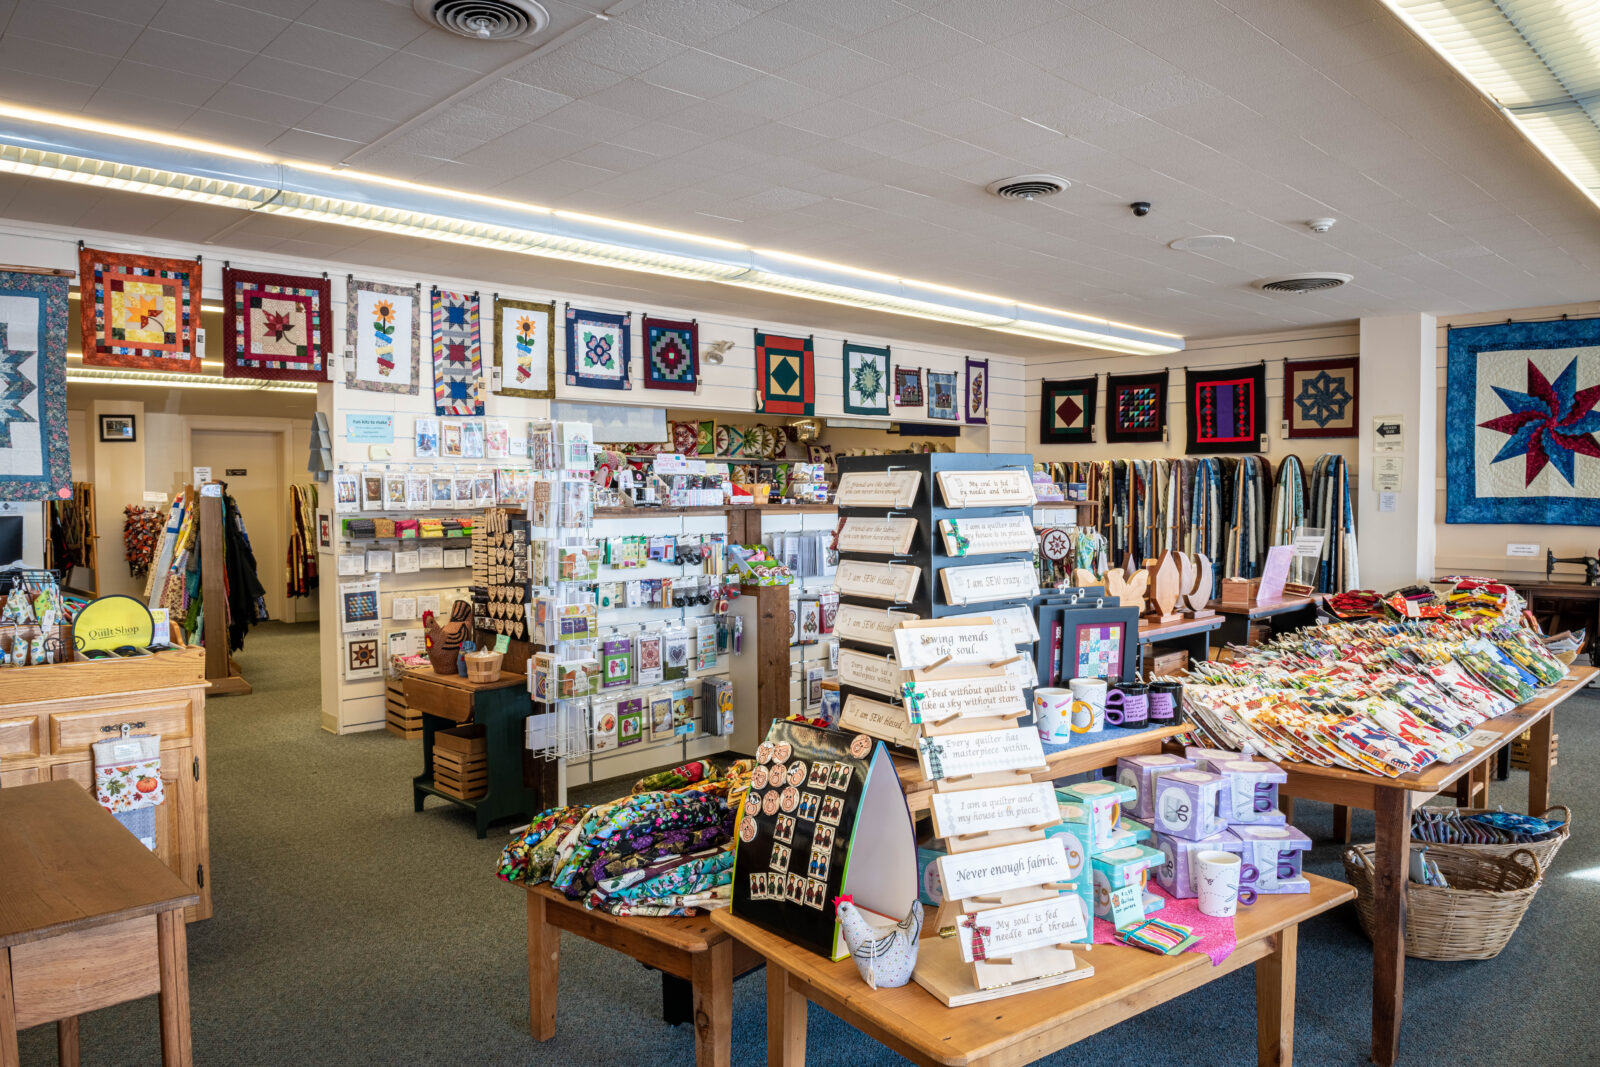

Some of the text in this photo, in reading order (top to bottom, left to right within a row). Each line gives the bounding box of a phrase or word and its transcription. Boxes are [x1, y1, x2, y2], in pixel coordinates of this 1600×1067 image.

[989, 487, 1000, 495] and
[967, 578, 971, 589] I
[973, 580, 984, 588] am
[986, 575, 1002, 586] SEW
[89, 625, 139, 640] Quilt Shop
[920, 630, 988, 646] Sewing mends
[936, 644, 979, 656] the soul.
[924, 683, 1016, 699] A bed without quilts is
[921, 694, 1021, 711] like a sky without stars.
[860, 712, 869, 720] am
[869, 712, 883, 724] SEW
[946, 733, 1019, 750] Every quilter has
[952, 747, 1000, 758] masterpiece
[1003, 743, 1031, 754] within.
[961, 801, 966, 811] I
[967, 802, 980, 810] am
[989, 798, 1015, 811] quilter
[1017, 796, 1033, 805] and
[957, 807, 1041, 824] my house is in pieces.
[956, 853, 1058, 883] Never enough fabric.
[995, 908, 1058, 930] My soul is fed
[995, 930, 1023, 942] needle
[1026, 926, 1044, 937] and
[1048, 918, 1078, 934] thread.
